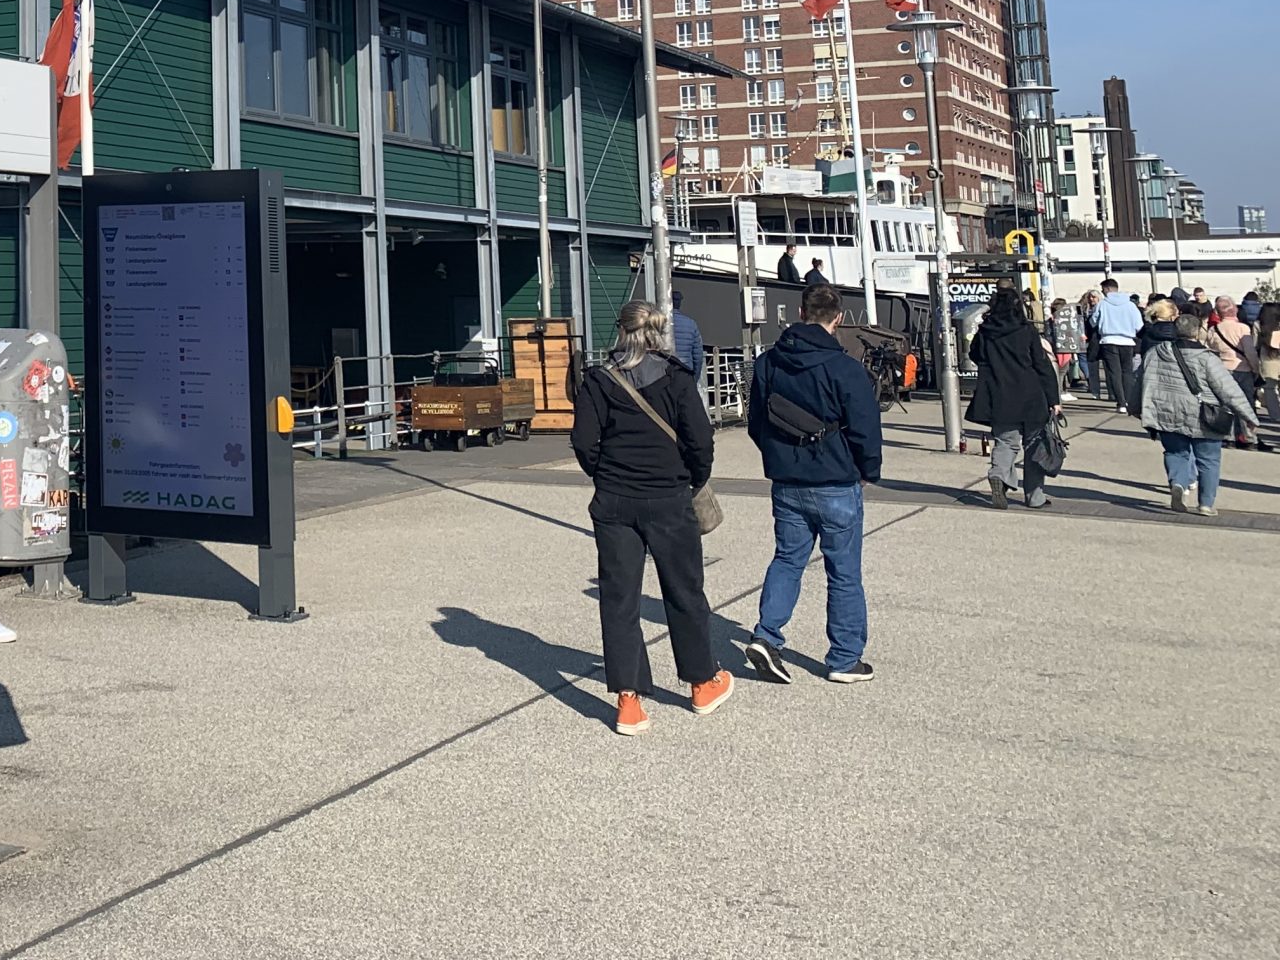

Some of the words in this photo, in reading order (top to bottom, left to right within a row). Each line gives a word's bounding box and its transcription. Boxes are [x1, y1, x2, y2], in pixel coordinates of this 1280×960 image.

[949, 284, 998, 294] OWAR
[949, 294, 992, 302] ARPEND
[157, 491, 236, 510] HADAG
